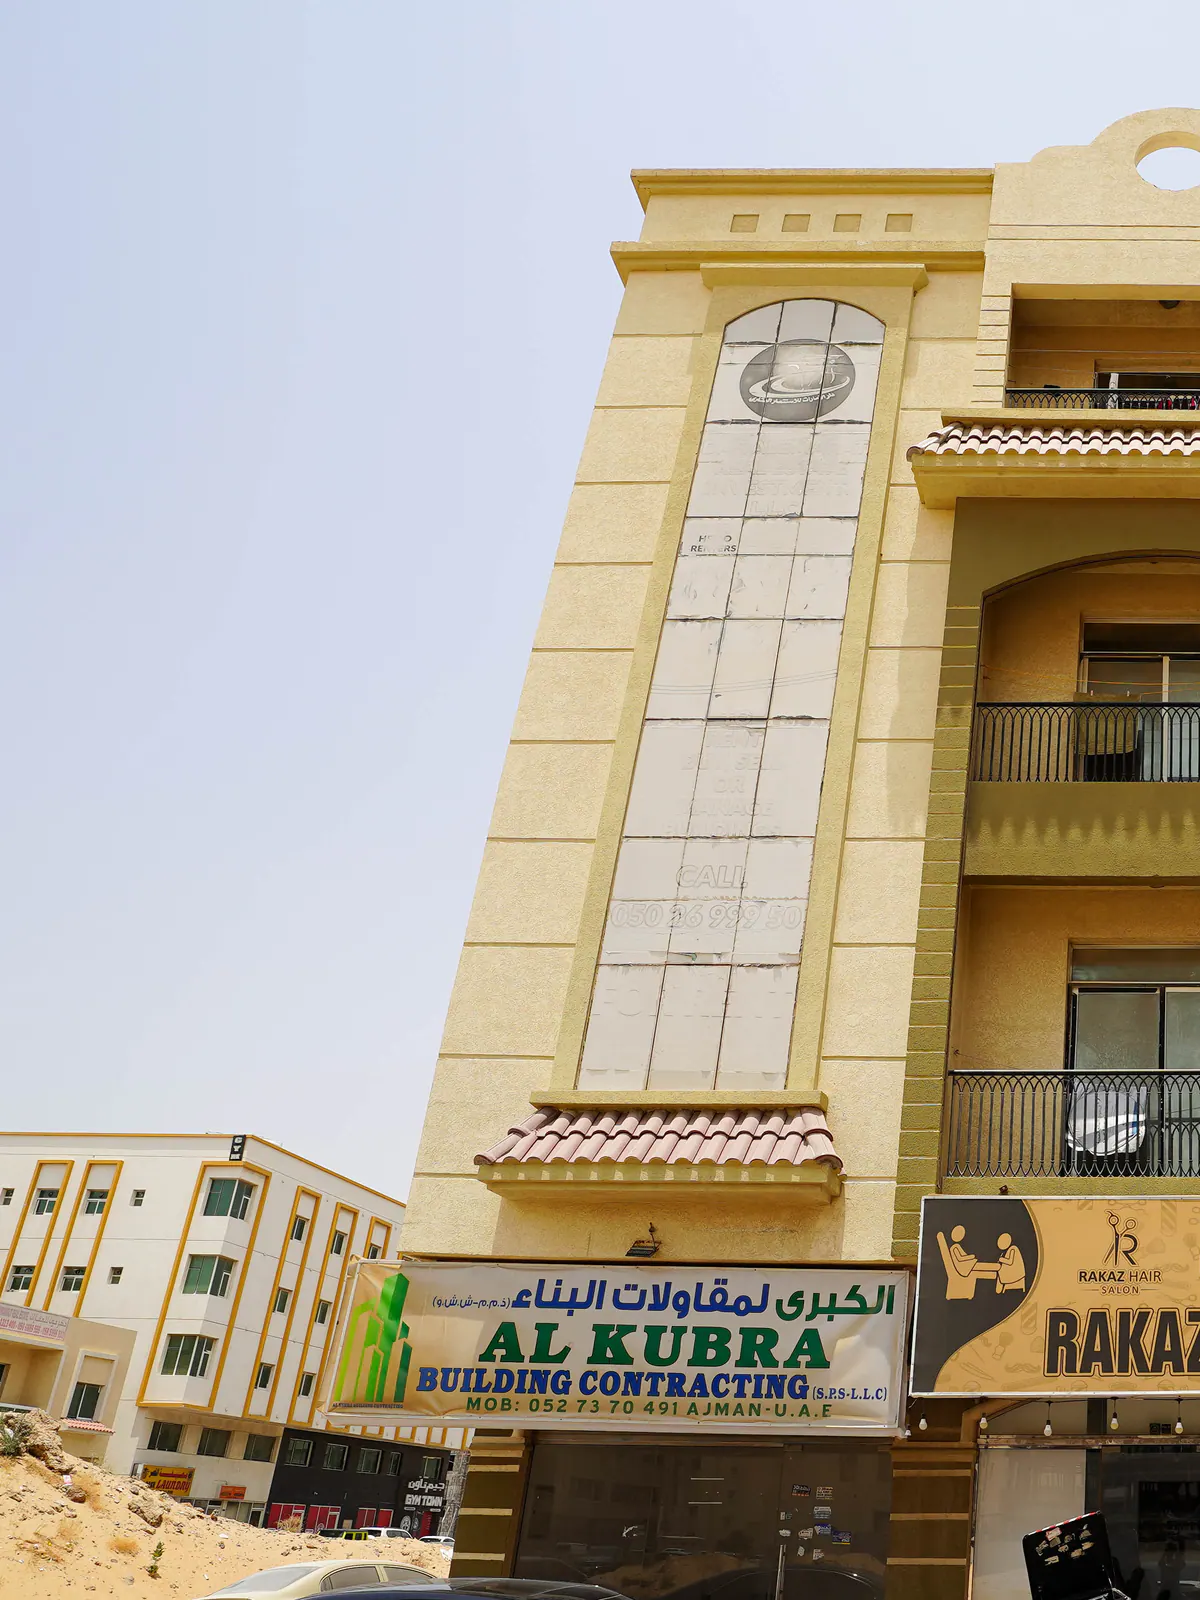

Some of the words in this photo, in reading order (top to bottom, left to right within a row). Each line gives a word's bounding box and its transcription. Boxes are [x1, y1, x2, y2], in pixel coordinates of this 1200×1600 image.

[676, 864, 748, 889] CALL
[611, 903, 663, 929] 050
[708, 904, 761, 930] 999
[765, 905, 803, 931] 50
[1079, 1271, 1125, 1282] RAKAZ
[1129, 1271, 1162, 1282] HAIR
[1101, 1286, 1139, 1294] SALON
[512, 1278, 608, 1317] البناء
[612, 1278, 770, 1319] لمقاولات
[775, 1284, 896, 1321] الكبرى
[478, 1321, 572, 1364] AL
[587, 1323, 831, 1369] KUBRA
[415, 1366, 573, 1397] BUILDING
[578, 1369, 810, 1400] CONTRACTING
[465, 1396, 521, 1412] MOB:
[528, 1398, 568, 1413] 052
[576, 1399, 601, 1414] 73
[609, 1400, 635, 1414] 70
[643, 1401, 679, 1416] 491
[405, 1494, 422, 1506] GYM
[422, 1495, 443, 1507] TOWN
